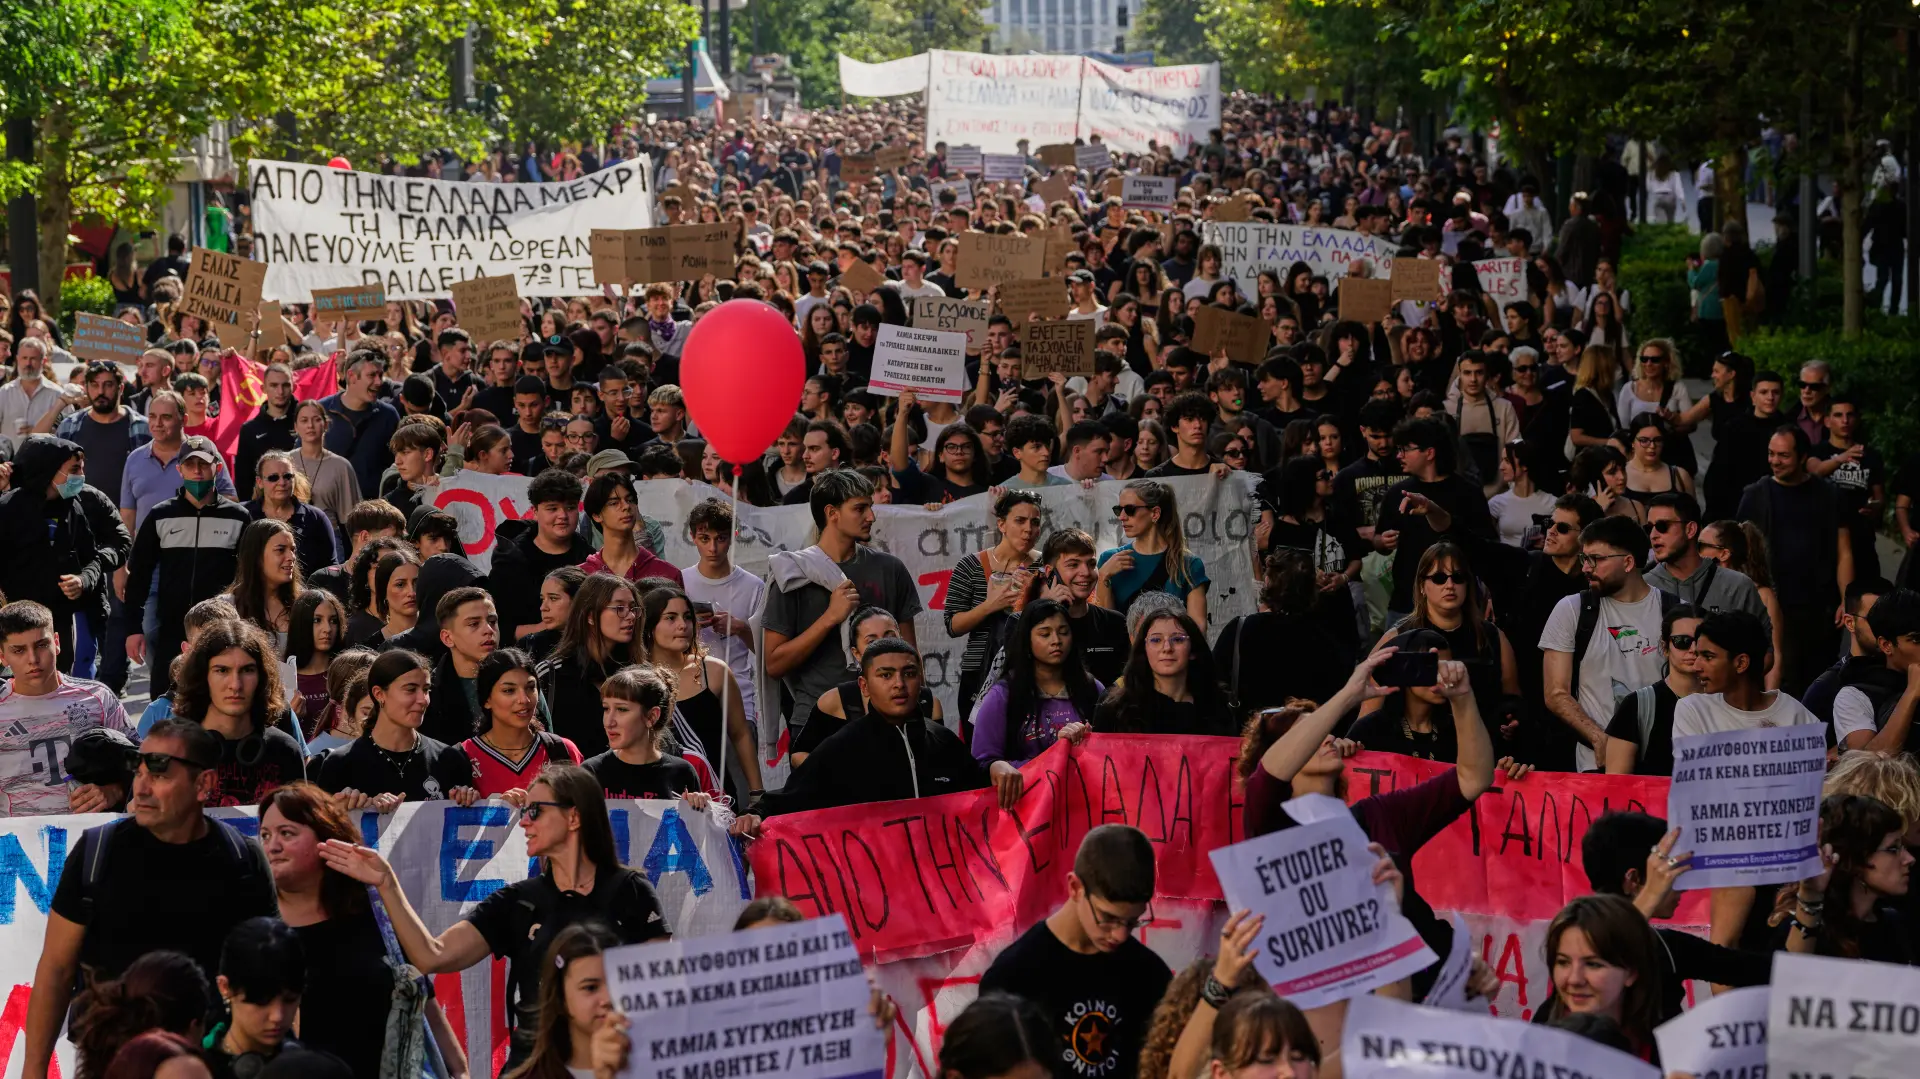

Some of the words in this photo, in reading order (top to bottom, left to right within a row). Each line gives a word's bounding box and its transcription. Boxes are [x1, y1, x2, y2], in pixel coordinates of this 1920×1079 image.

[252, 165, 323, 204] ΑΠΟ
[333, 171, 396, 212] ΤΗΝ
[406, 182, 534, 214] ΕΛΛΑΔΑ
[540, 163, 647, 204] ΜΕΧΡΙ
[340, 212, 381, 239] ΤΗ
[398, 213, 512, 241] ΓΑΛΛΙΑ
[1211, 226, 1247, 245] ΑΠΟ
[1253, 228, 1292, 246] ΤΗΝ
[1302, 230, 1376, 252] ΕΛΛΑΔΑ
[253, 232, 415, 264] ΠΑΛΕΥΟΥΜΕ
[431, 243, 472, 261] ΓΙΑ
[1223, 247, 1247, 262] ΗΝ
[1257, 247, 1322, 263] ΓΑΛΛΙΑ
[201, 253, 242, 280] ΕΛΛΑΣ
[190, 275, 242, 306] ΓΑΛΛΙΑ
[1487, 279, 1518, 297] LES
[919, 303, 934, 318] LE
[938, 316, 958, 328] EST
[886, 341, 906, 351] ΤΡΙΠΛΕΣ
[906, 344, 960, 356] ΠΑΝΕΛΛΑΔΙΚΕΣ!
[896, 331, 912, 339] ΚΑΜΙΑ
[913, 333, 937, 342] ΣΚΕΨΗ
[884, 371, 910, 381] ΤΡΑΠΕΖΑΣ
[911, 375, 946, 384] ΘΕΜΑΤΩΝ
[887, 359, 918, 370] ΚΑΤΑΡΓΗΣΗ
[1697, 740, 1768, 759] ΚΑΛΥΦΘΟΥΝ
[1792, 737, 1805, 751] ΚΑΙ
[1807, 735, 1825, 749] ΤΩΡΑ
[1675, 768, 1696, 783] ΟΛΑ
[1699, 767, 1712, 781] ΤΑ
[1715, 765, 1750, 780] ΚΕΝΑ
[1691, 803, 1739, 821] ΚΑΜΙΑ
[1744, 795, 1816, 818] ΣΥΓΧΩΝΕΥΣΗ
[1695, 828, 1707, 843] 15
[1711, 822, 1782, 842] ΜΑΘΗΤΕΣ
[884, 807, 1010, 914] ΤΗΝ
[1255, 838, 1348, 896] ÉTUDIER
[776, 829, 890, 939] ΑΠΟ
[1298, 882, 1329, 917] OU
[1267, 899, 1380, 968] SURVIVRE?
[617, 963, 644, 984] ΝΑ
[648, 947, 760, 980] ΚΑΛΥΦΘΟΥΝ
[802, 934, 828, 956] ΚΑΙ
[621, 991, 658, 1013] ΟΛΑ
[663, 988, 687, 1009] ΤΑ
[690, 981, 736, 1004] ΚΕΝΑ
[1064, 1000, 1122, 1025] ΚΟΙΝΟΙ
[1788, 996, 1837, 1029] ΝΑ
[1848, 1001, 1920, 1034] ΣΠΟ
[651, 1031, 718, 1061] ΚΑΜΙΑ
[722, 1008, 856, 1049] ΣΥΓΧΩΝΕΥΣΗ
[1360, 1034, 1409, 1060] ΝΑ
[1706, 1021, 1768, 1049] ΣΥΓΧ
[684, 1050, 780, 1079] ΜΑΘΗΤΕΣ
[800, 1038, 851, 1066] ΤΑΞΗ
[1062, 1048, 1120, 1077] ΘΝΗΤΟΙ
